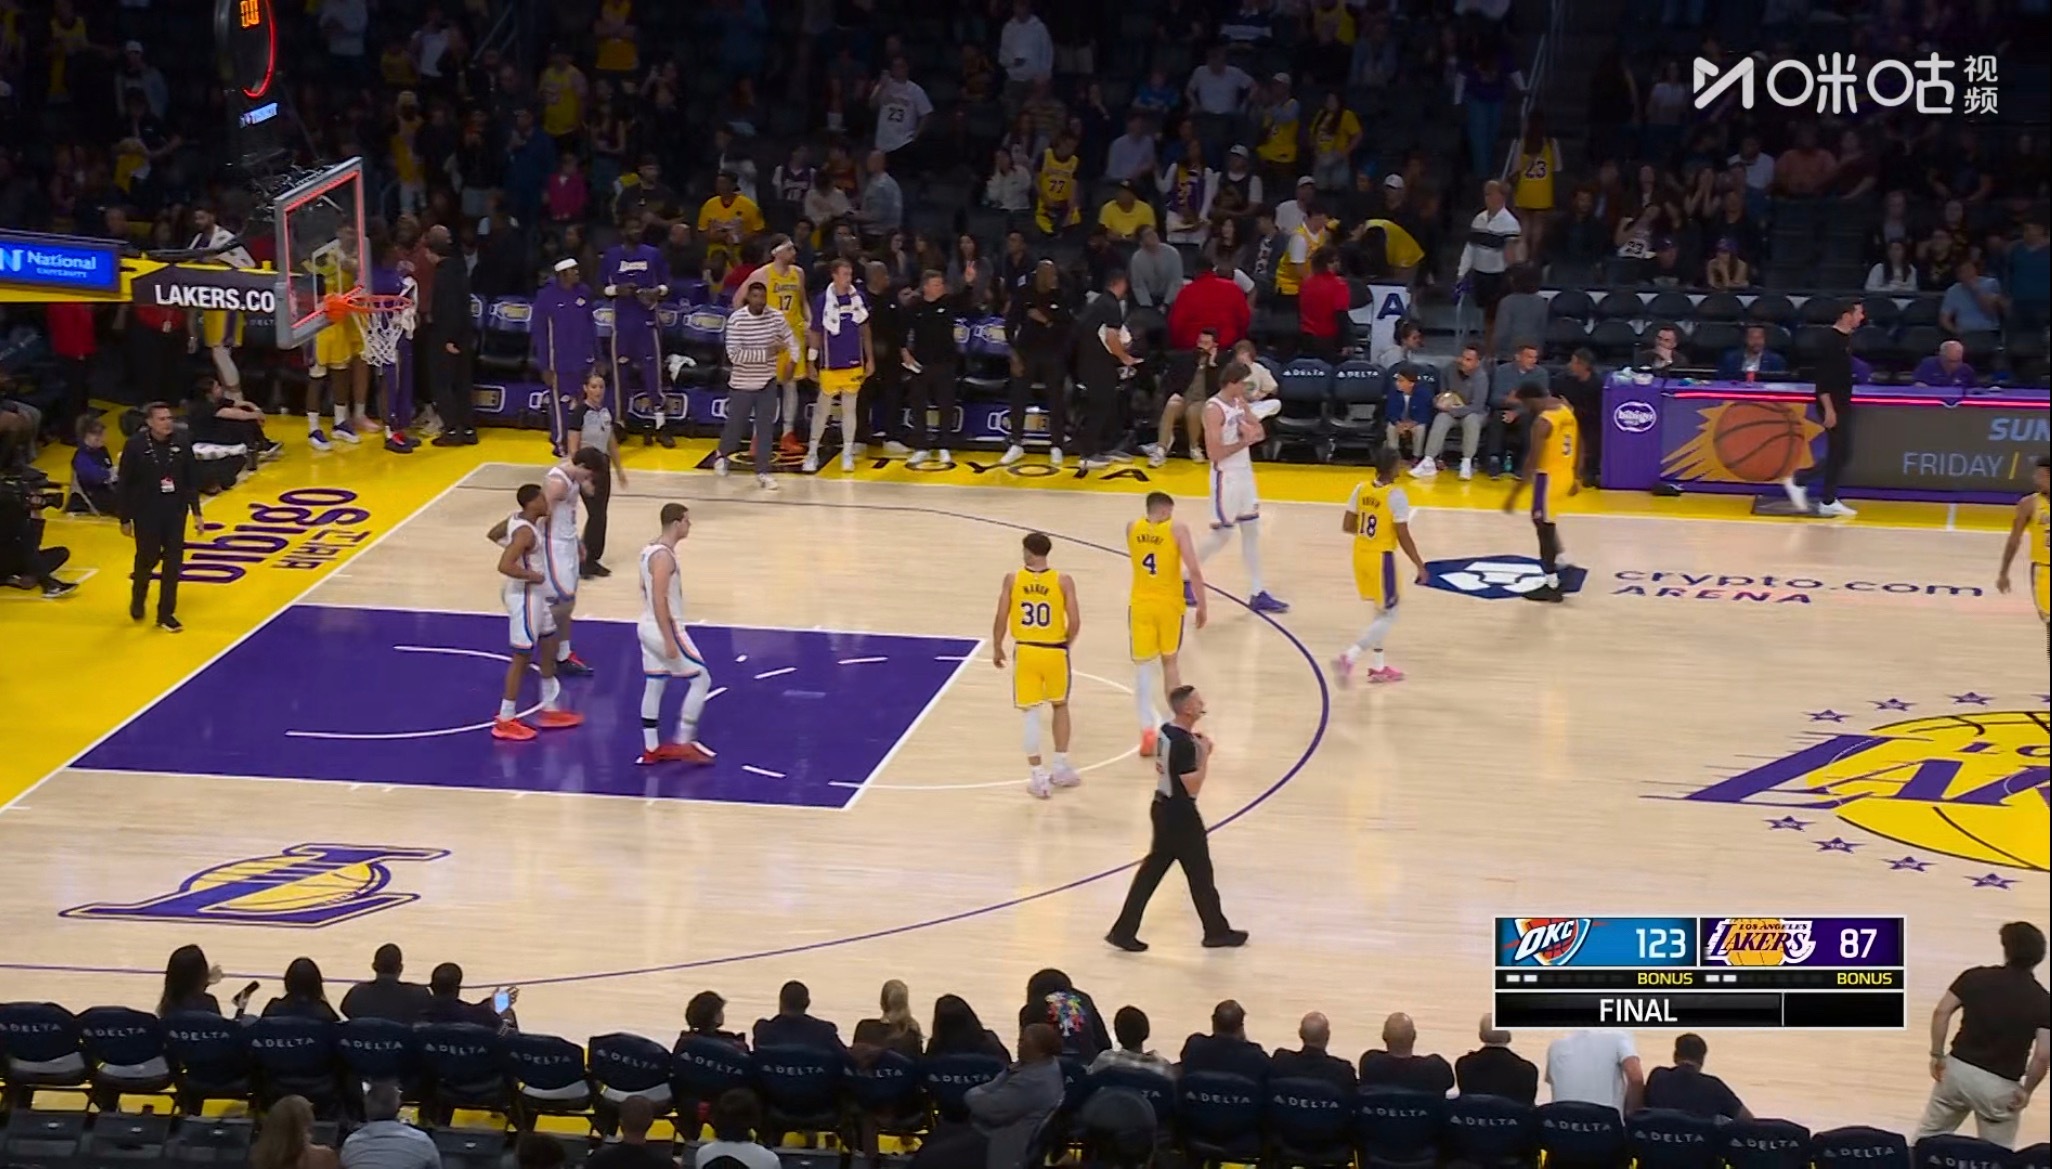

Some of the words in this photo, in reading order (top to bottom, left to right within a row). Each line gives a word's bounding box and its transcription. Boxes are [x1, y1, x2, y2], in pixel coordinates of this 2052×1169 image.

[27, 250, 97, 270] National
[155, 284, 275, 313] LAKERS.CO
[779, 295, 792, 311] 17
[868, 457, 1151, 482] TOYOTA
[1903, 452, 2003, 478] FRIDAY
[1360, 511, 1378, 538] 18
[1142, 553, 1157, 575] 4
[1614, 570, 1984, 598] crypto.com
[1611, 585, 1812, 604] ARENA
[1020, 601, 1051, 627] 30
[10, 1023, 61, 1032] DELTA
[97, 1027, 146, 1037] DELTA
[181, 1030, 230, 1040] DELTA
[265, 1038, 315, 1048] DELTA
[353, 1039, 402, 1050] DELTA
[523, 1052, 571, 1064] DELTA
[611, 1052, 659, 1070] DELTA
[695, 1056, 743, 1076] DELTA
[776, 1065, 824, 1076] DELTA
[943, 1073, 991, 1083] DELTA
[1200, 1093, 1250, 1104] DELTA
[1288, 1097, 1338, 1109] DELTA
[1377, 1107, 1428, 1117] DELTA
[1466, 1117, 1518, 1126] DELTA
[1559, 1121, 1611, 1132] DELTA
[1652, 1131, 1704, 1143] DELTA
[1747, 1139, 1798, 1150] DELTA
[1840, 1146, 1894, 1157] DELTA
